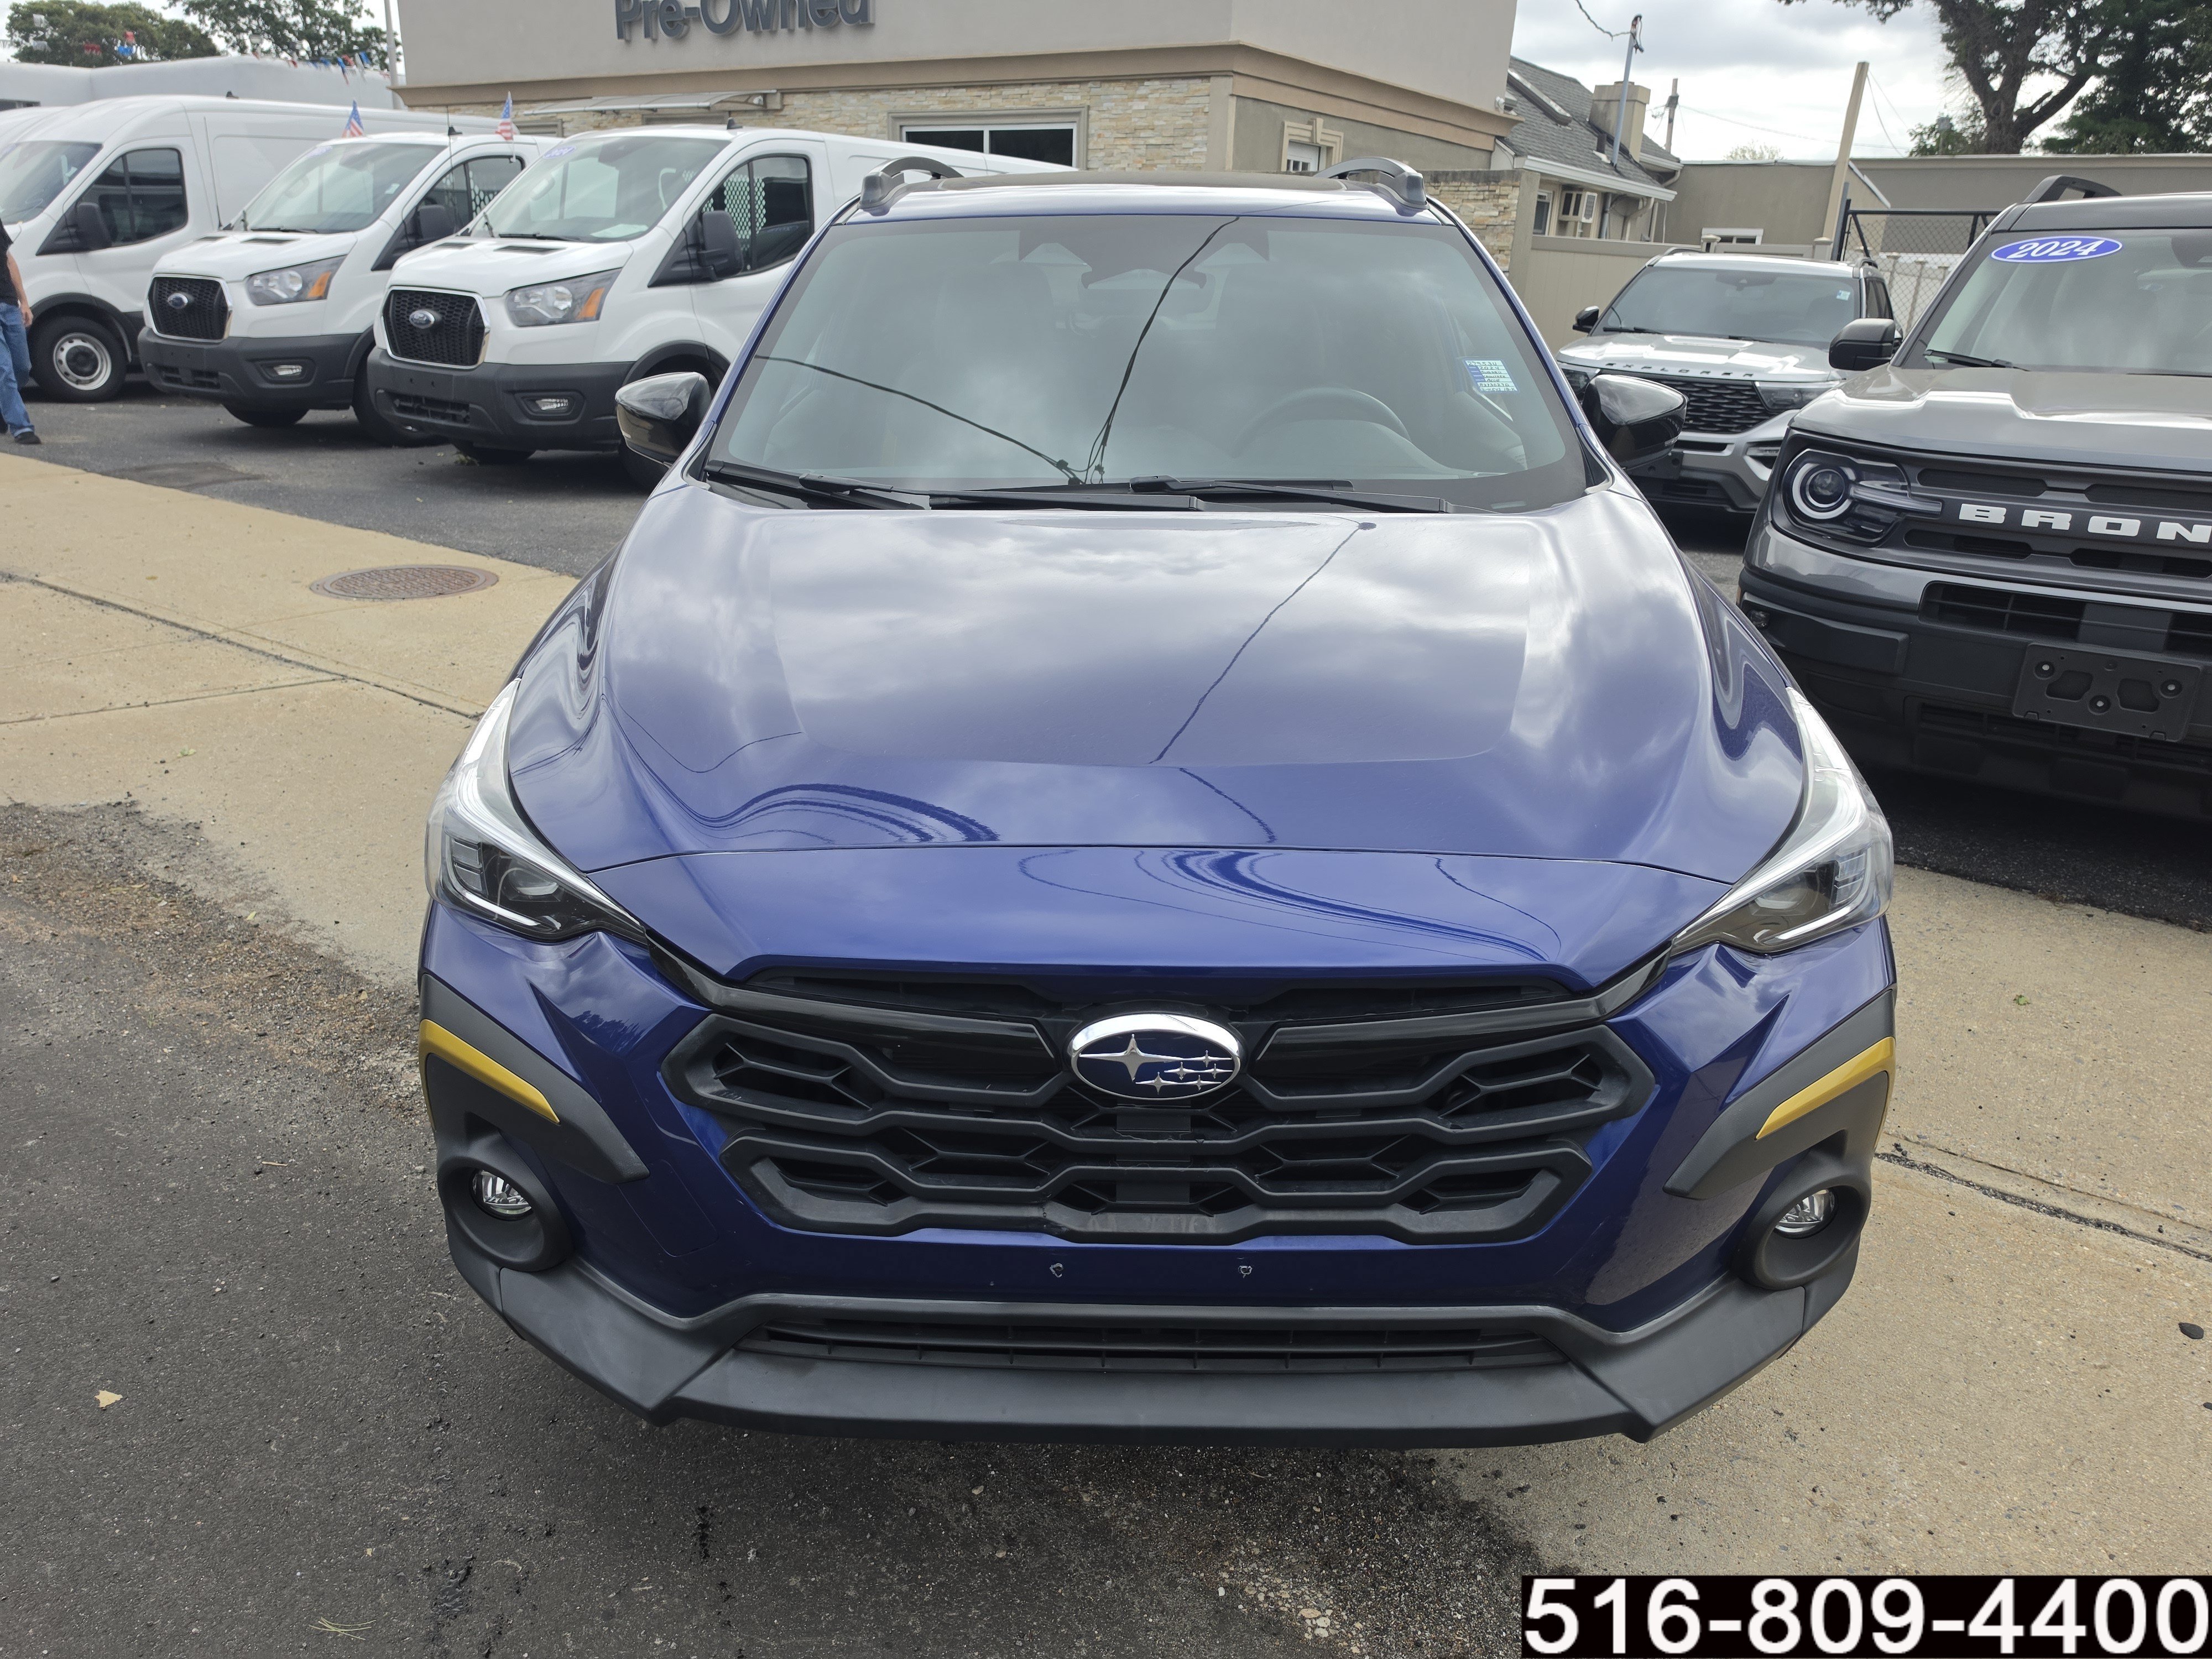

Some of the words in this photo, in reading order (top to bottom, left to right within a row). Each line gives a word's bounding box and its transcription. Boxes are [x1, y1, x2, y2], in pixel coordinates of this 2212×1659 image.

[2006, 239, 2105, 259] 2024
[1605, 362, 1754, 377] EXPLORER
[1959, 504, 2212, 543] BRON
